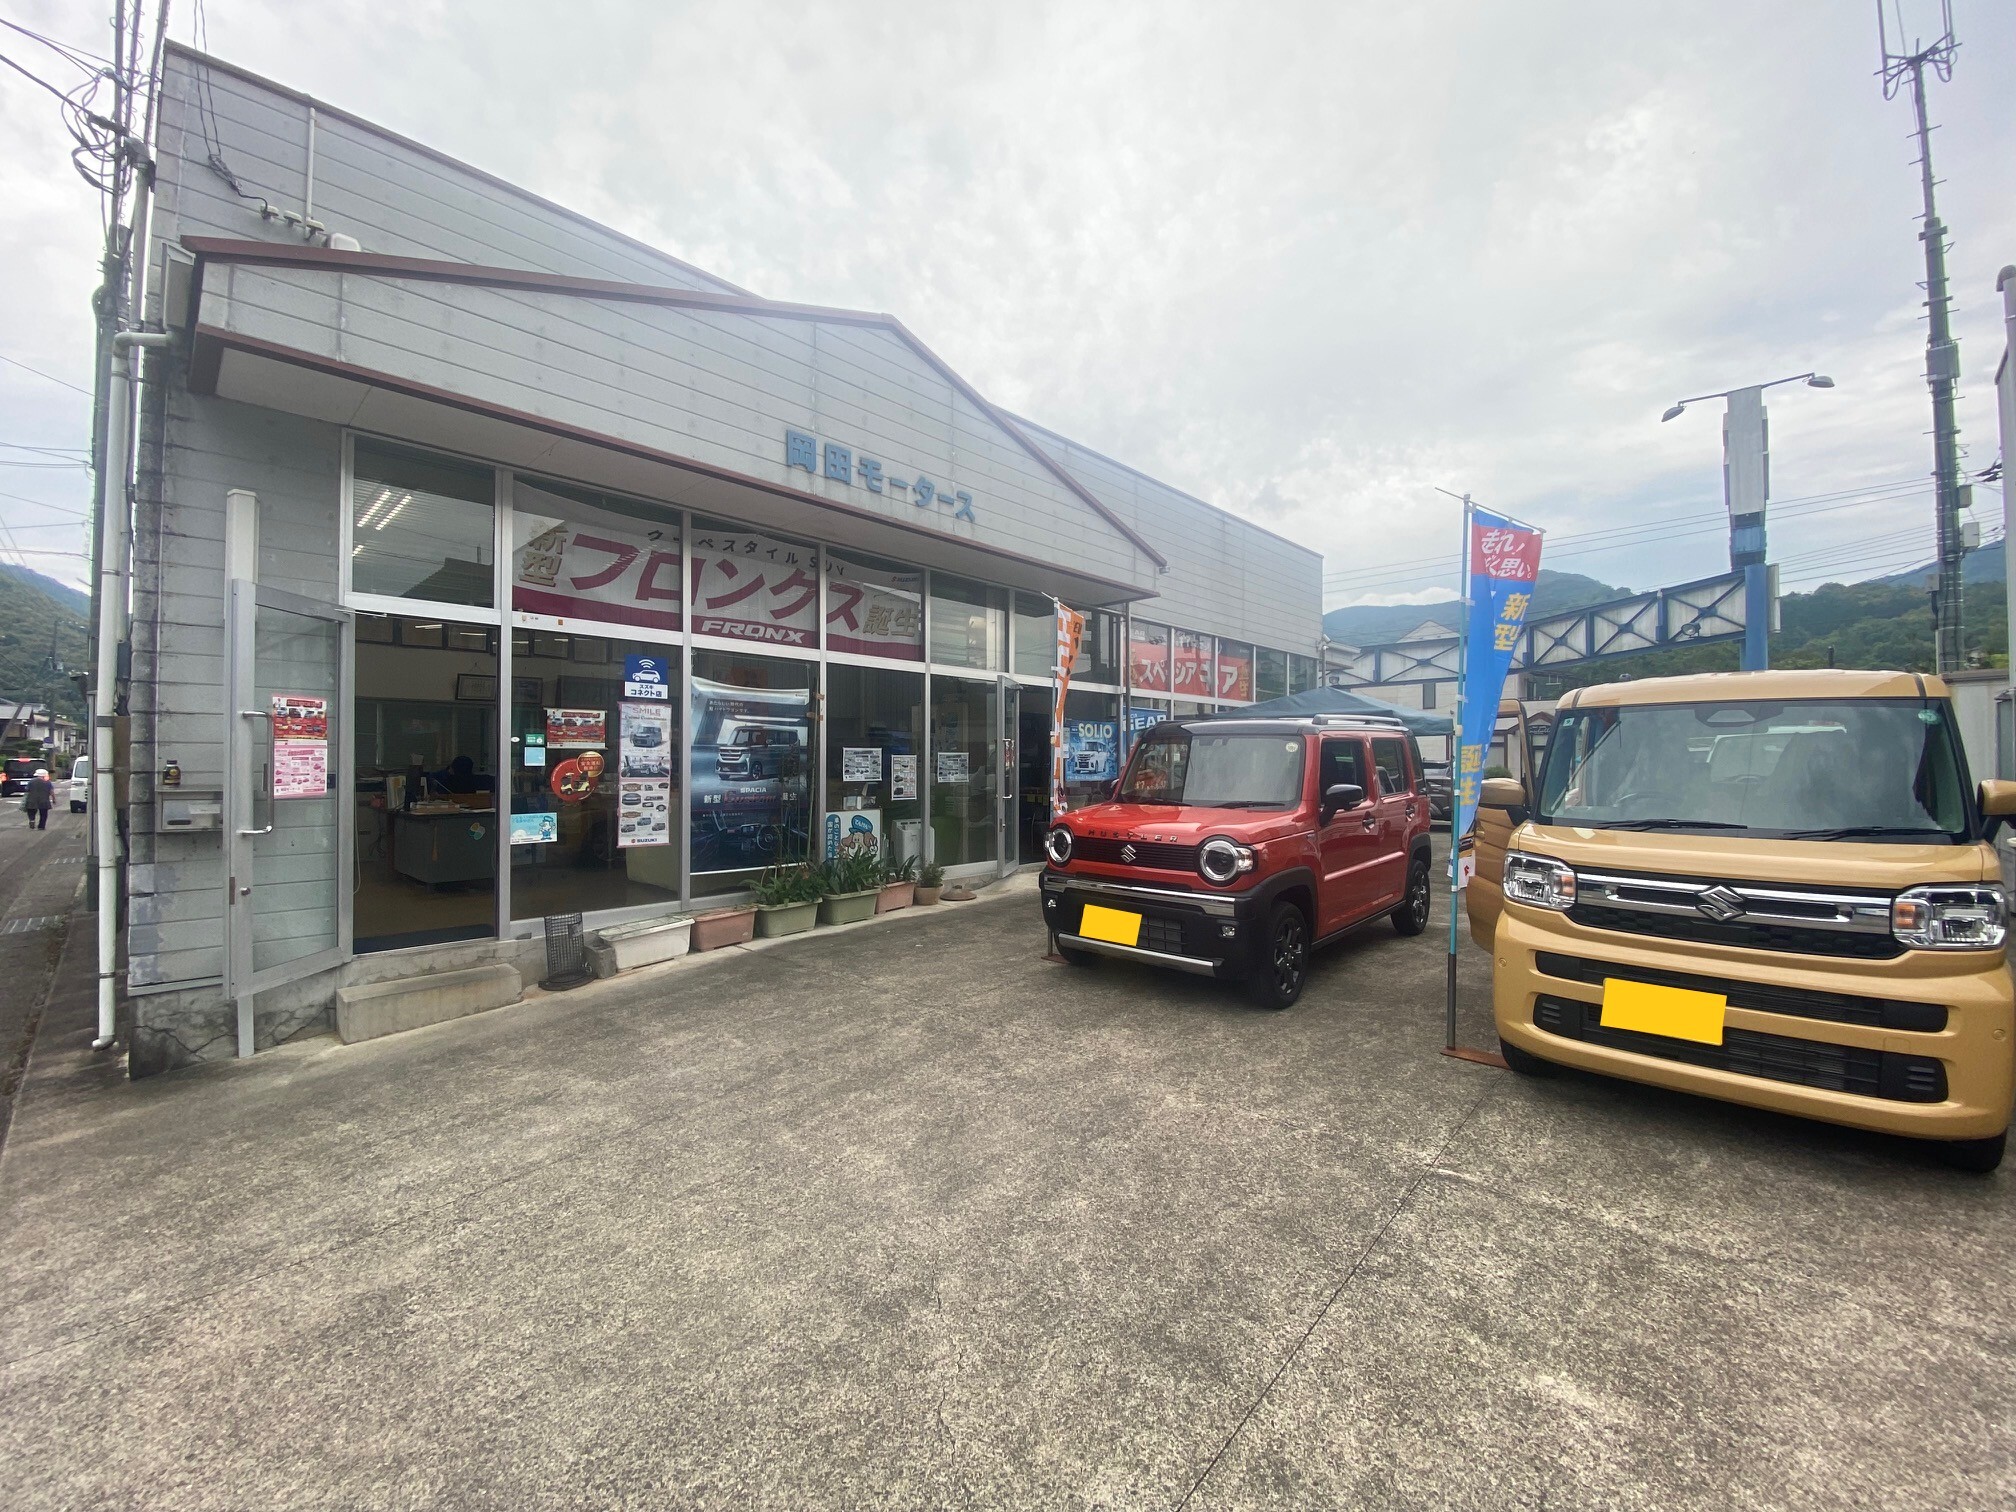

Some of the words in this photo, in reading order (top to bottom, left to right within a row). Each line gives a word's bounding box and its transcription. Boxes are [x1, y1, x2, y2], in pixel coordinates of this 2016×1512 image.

[786, 430, 976, 524] 岡田モータース
[570, 533, 865, 632] フロンクス
[701, 620, 806, 644] FRONX
[863, 605, 919, 637] 誕生
[1494, 593, 1531, 651] 新型
[633, 707, 661, 716] SMILE
[1078, 723, 1112, 738] SOLIO
[703, 794, 722, 804] 新型
[1088, 829, 1178, 843] HUSTLER
